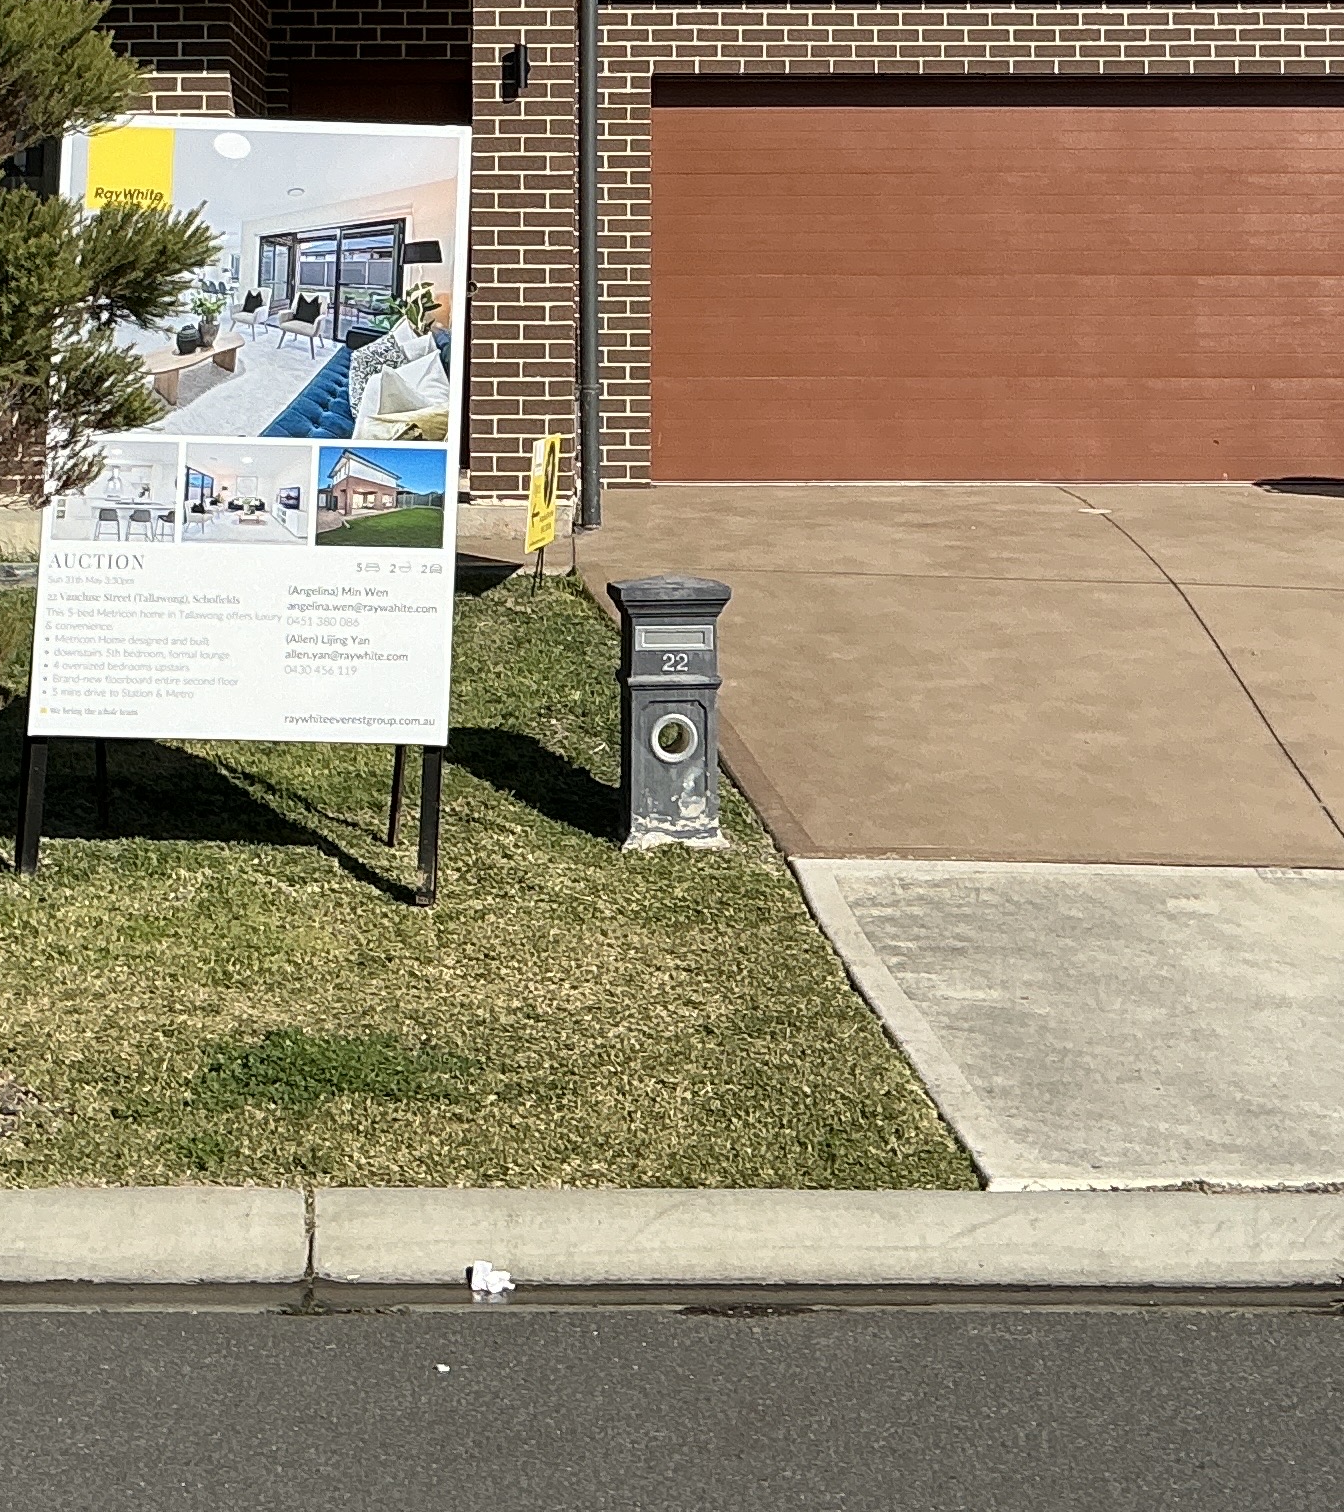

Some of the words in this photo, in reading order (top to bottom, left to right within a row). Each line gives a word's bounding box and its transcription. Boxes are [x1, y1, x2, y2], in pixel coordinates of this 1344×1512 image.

[48, 553, 145, 570] AUCTION
[356, 562, 363, 573] 5
[389, 563, 397, 574] 2
[420, 564, 428, 574] 2
[85, 576, 102, 585] May
[288, 584, 339, 597] (Angelina)
[341, 586, 361, 597] Min
[364, 587, 389, 597] Wen
[47, 593, 58, 601] 22
[103, 592, 132, 603] Street
[192, 593, 241, 605] Schofields
[46, 607, 64, 617] This
[96, 608, 138, 618] Metricon
[140, 609, 166, 619] home
[167, 609, 177, 619] in
[225, 611, 253, 621] offers
[287, 616, 313, 627] 0451
[316, 616, 337, 627] 380
[339, 617, 360, 627] 086
[54, 634, 96, 644] Metricon
[98, 635, 126, 645] Home
[128, 635, 169, 647] designed
[170, 636, 188, 646] and
[285, 633, 319, 645] (Allen)
[350, 635, 371, 645] Yan
[168, 649, 198, 659] formal
[199, 650, 231, 661] lounge
[284, 649, 409, 662] allen.yan@raywhite.com
[107, 662, 153, 671] bedrooms
[154, 663, 191, 673] upstairs
[662, 653, 689, 672] 22
[284, 664, 312, 675] 0430
[314, 665, 334, 676] 456
[337, 665, 358, 676] 119
[154, 676, 181, 685] entire
[182, 676, 216, 686] second
[217, 676, 239, 686] floor
[60, 688, 82, 697] mins
[83, 688, 107, 698] drive
[109, 688, 119, 698] to
[121, 688, 154, 698] Station
[155, 688, 163, 698] &
[165, 688, 194, 699] Metro
[284, 714, 436, 727] raywhiteeverestgroup.com.au
